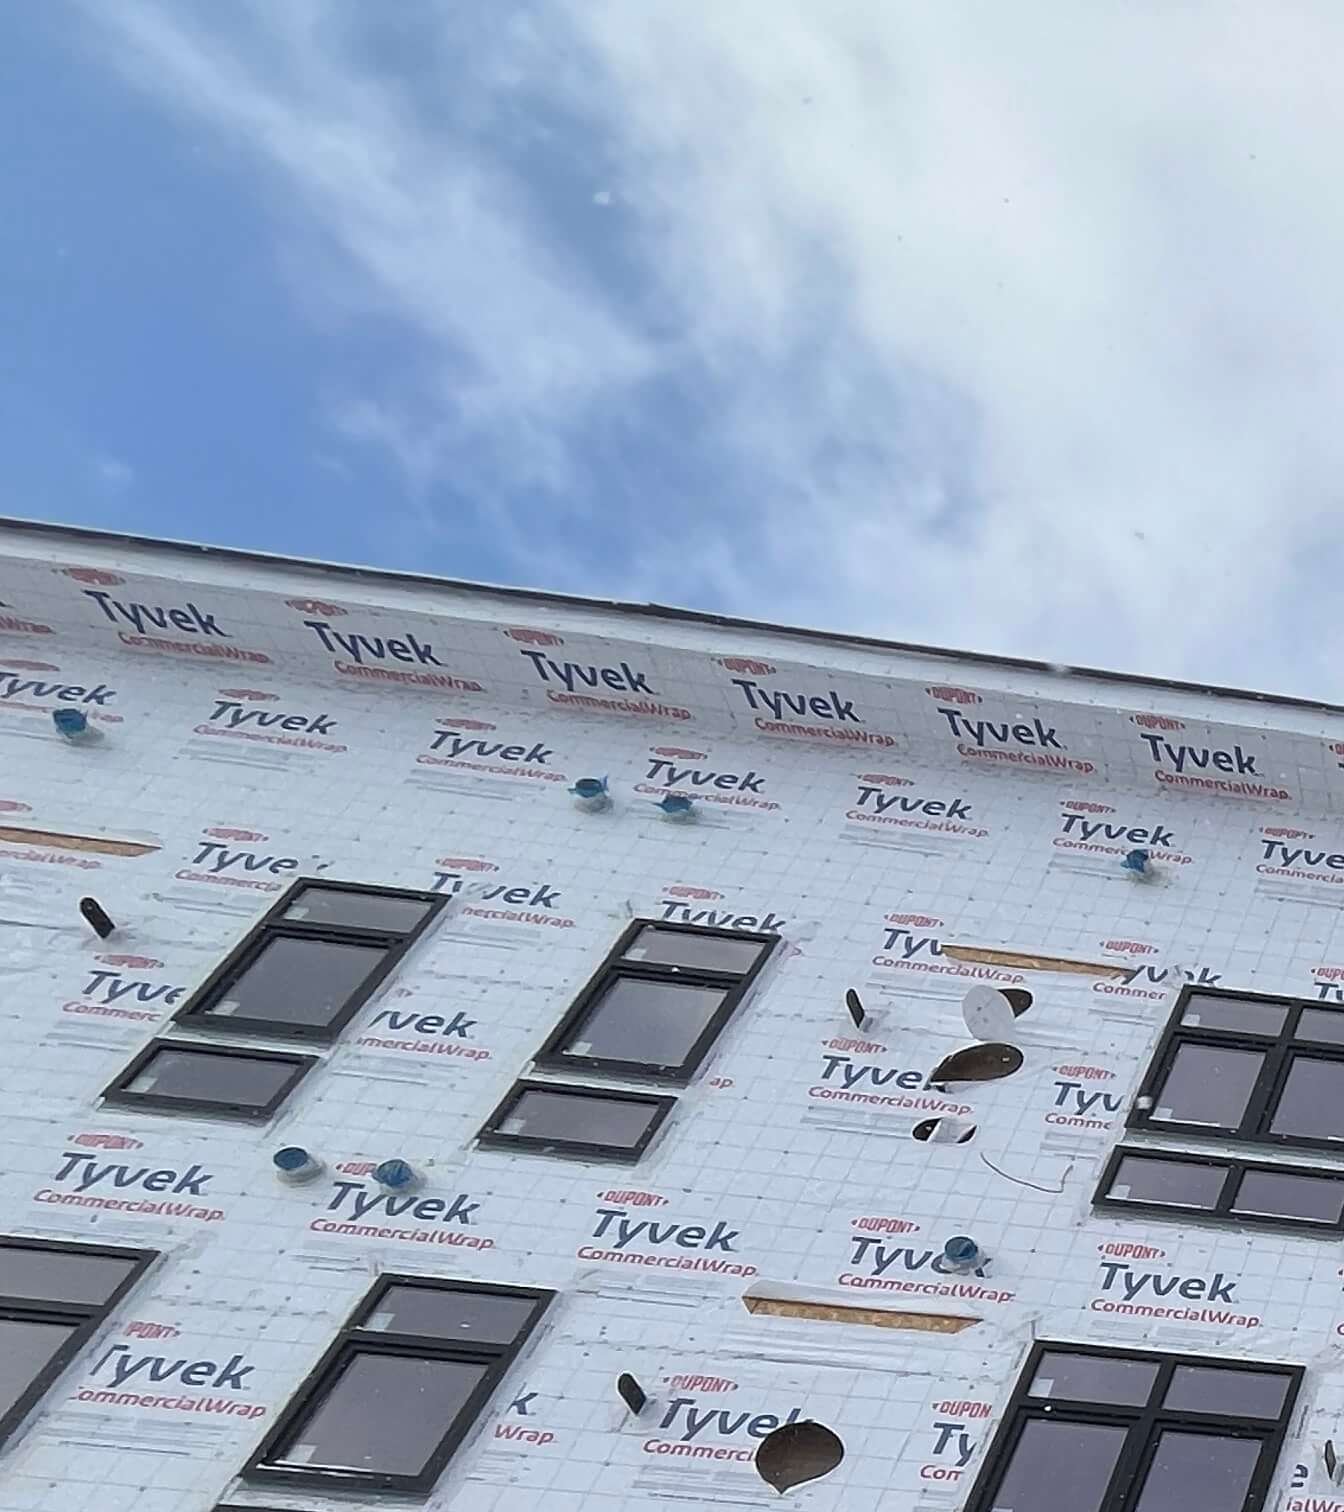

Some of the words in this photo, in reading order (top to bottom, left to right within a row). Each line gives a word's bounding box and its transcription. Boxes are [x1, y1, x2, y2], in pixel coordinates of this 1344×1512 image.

[84, 591, 225, 636] Tyvek
[305, 621, 442, 666] Tyvek
[521, 650, 654, 693] Tyvek
[732, 679, 861, 723] Tyvek
[210, 701, 338, 736] Tyvek
[754, 718, 894, 747] CommercialWrap
[938, 707, 1062, 749] Tyvek
[431, 731, 553, 765] Tyvek
[957, 745, 1094, 774] CommercialWrap
[1140, 734, 1257, 776] Tyvek
[646, 759, 765, 794] Tyvek
[1154, 770, 1288, 800] CommercialWrap
[854, 786, 973, 821] Tyvek
[845, 810, 986, 838] CommercialWrap
[1060, 813, 1174, 847] Tyvek
[872, 956, 1024, 983] CommercialWrap
[808, 1086, 971, 1115] CommercialWrap
[70, 1135, 141, 1150] DUPONT
[52, 1151, 212, 1197] Tyvek
[33, 1189, 225, 1222] CommercialWrap
[324, 1181, 480, 1226] Tyvek
[600, 1190, 666, 1207] DUPONT
[310, 1218, 495, 1251] CommercialWrap
[591, 1208, 739, 1251] Tyvek
[855, 1218, 918, 1233] DUPONT
[576, 1247, 757, 1278] CommercialWrap
[1102, 1243, 1163, 1259] DUPONT
[838, 1273, 1014, 1303] CommercialWrap
[1099, 1262, 1236, 1303] Tyvek
[1090, 1299, 1261, 1328] CommercialWrap
[668, 1376, 735, 1392] DUPONT
[938, 1401, 991, 1418] DUPON
